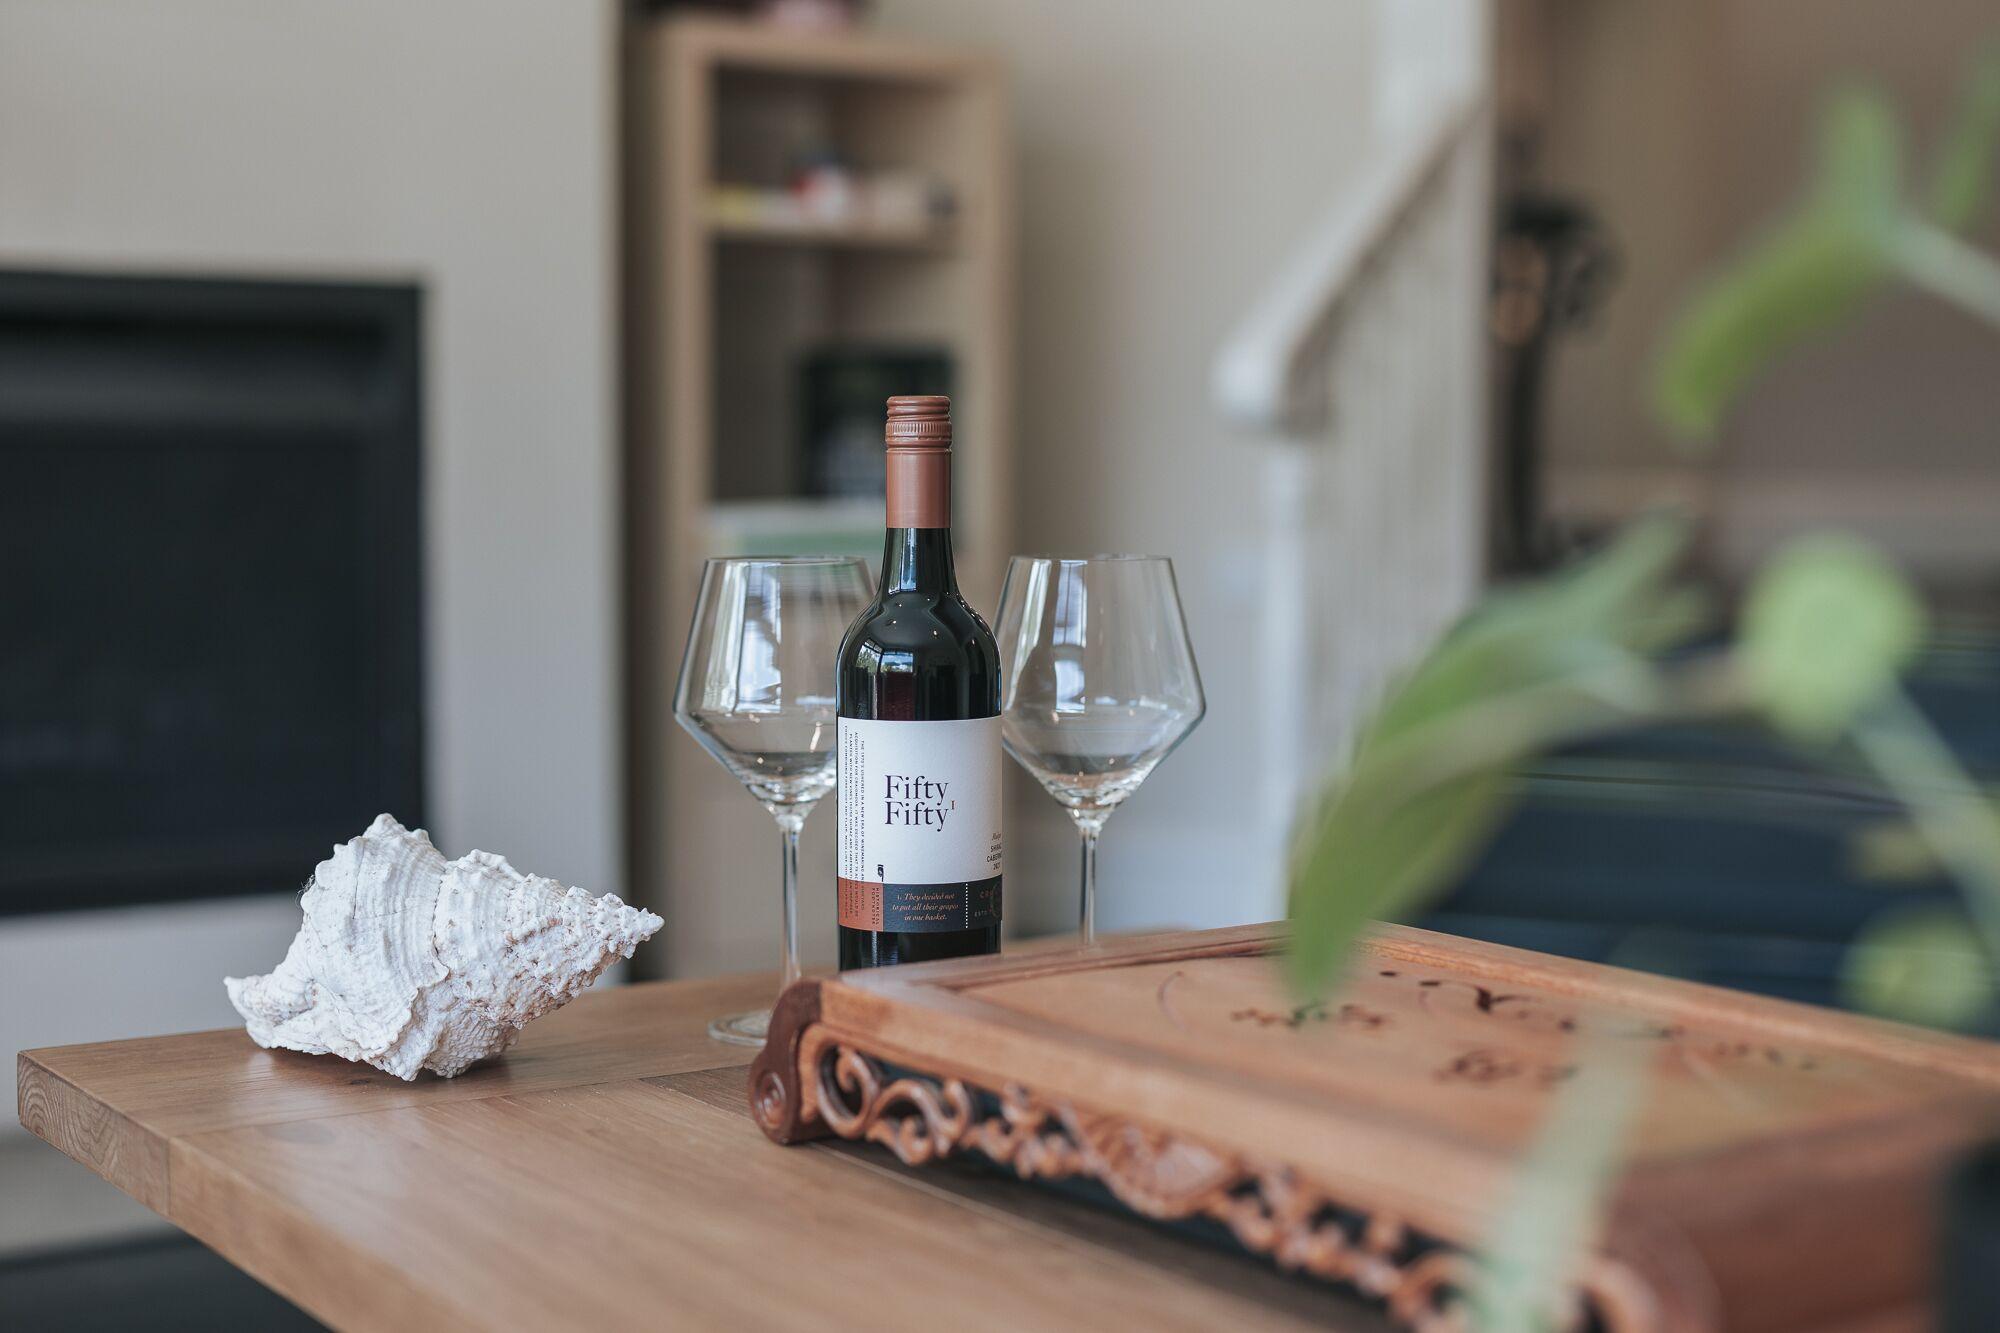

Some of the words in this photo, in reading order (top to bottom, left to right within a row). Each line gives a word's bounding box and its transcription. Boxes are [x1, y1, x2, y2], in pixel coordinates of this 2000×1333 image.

[884, 774, 949, 806] Fifty
[884, 801, 949, 832] Fifty
[904, 892, 921, 902] They
[922, 902, 938, 910] their
